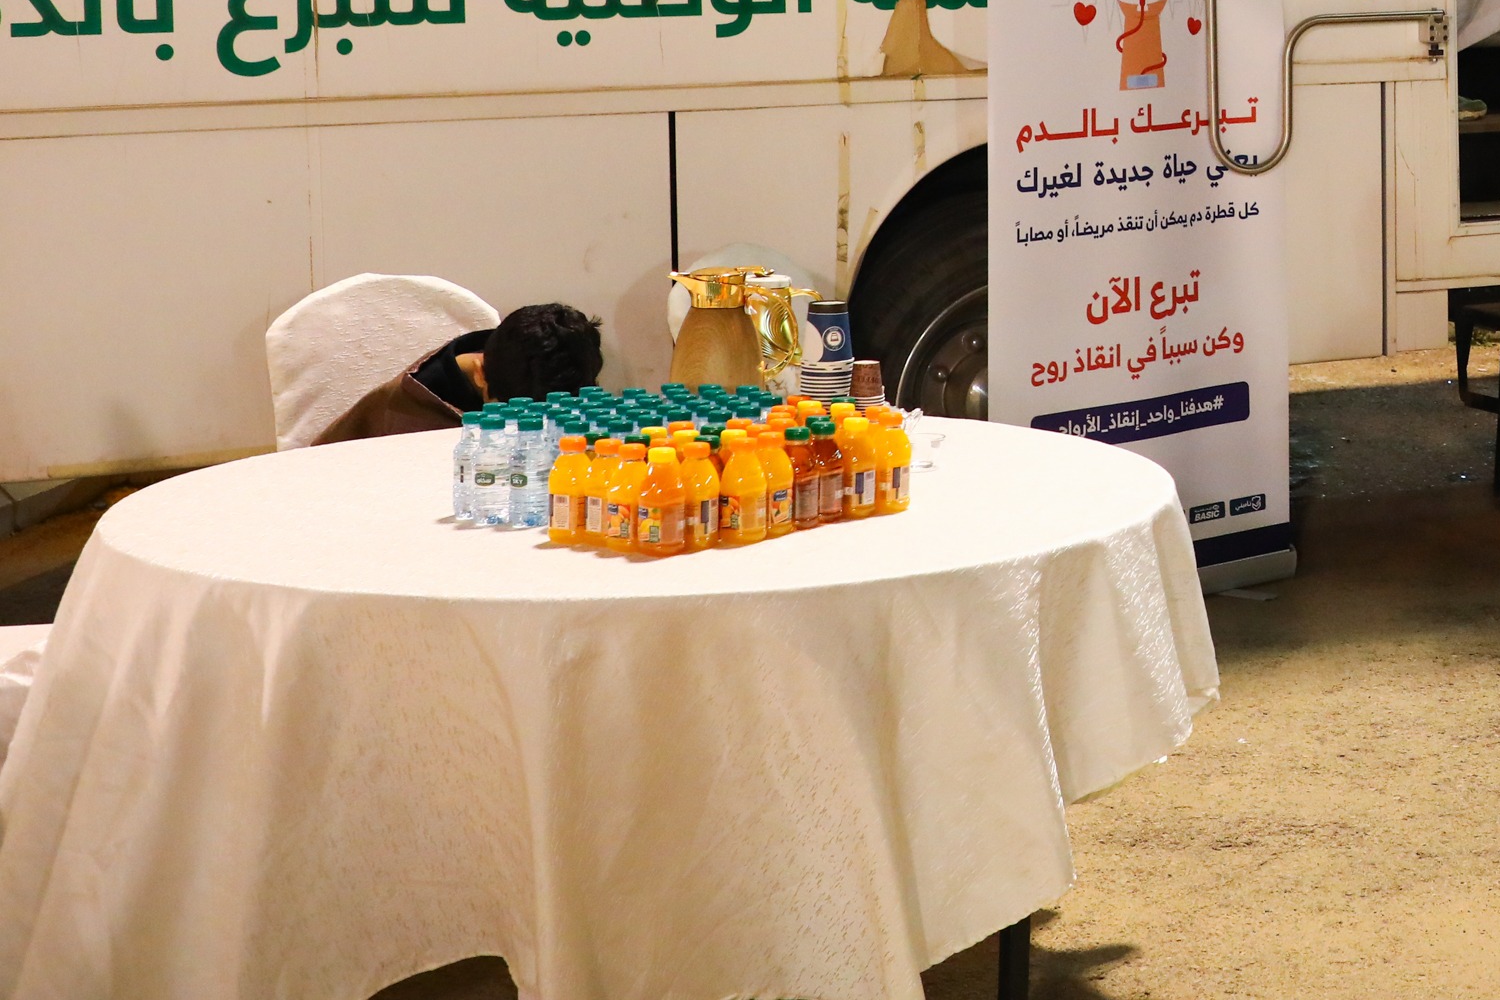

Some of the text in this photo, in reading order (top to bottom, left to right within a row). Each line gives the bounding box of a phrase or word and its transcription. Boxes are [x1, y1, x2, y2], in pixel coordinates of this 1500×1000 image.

[1017, 163, 1081, 198] لغيرك
[1094, 162, 1153, 191] جديدة
[1163, 154, 1197, 184] حياة
[1146, 210, 1157, 231] أن
[1161, 212, 1187, 229] يمكن
[1190, 212, 1202, 226] دم
[1205, 202, 1234, 222] قطرة
[1239, 202, 1259, 219] كل
[1057, 220, 1068, 242] أو
[1118, 216, 1143, 231] تنقذ
[1087, 270, 1200, 324] تبرع الآن
[1203, 327, 1244, 356] وكن
[1074, 344, 1120, 373] انقاذ
[1128, 337, 1156, 380] في
[1031, 361, 1067, 387] روح
[1194, 510, 1220, 522] BASIC
